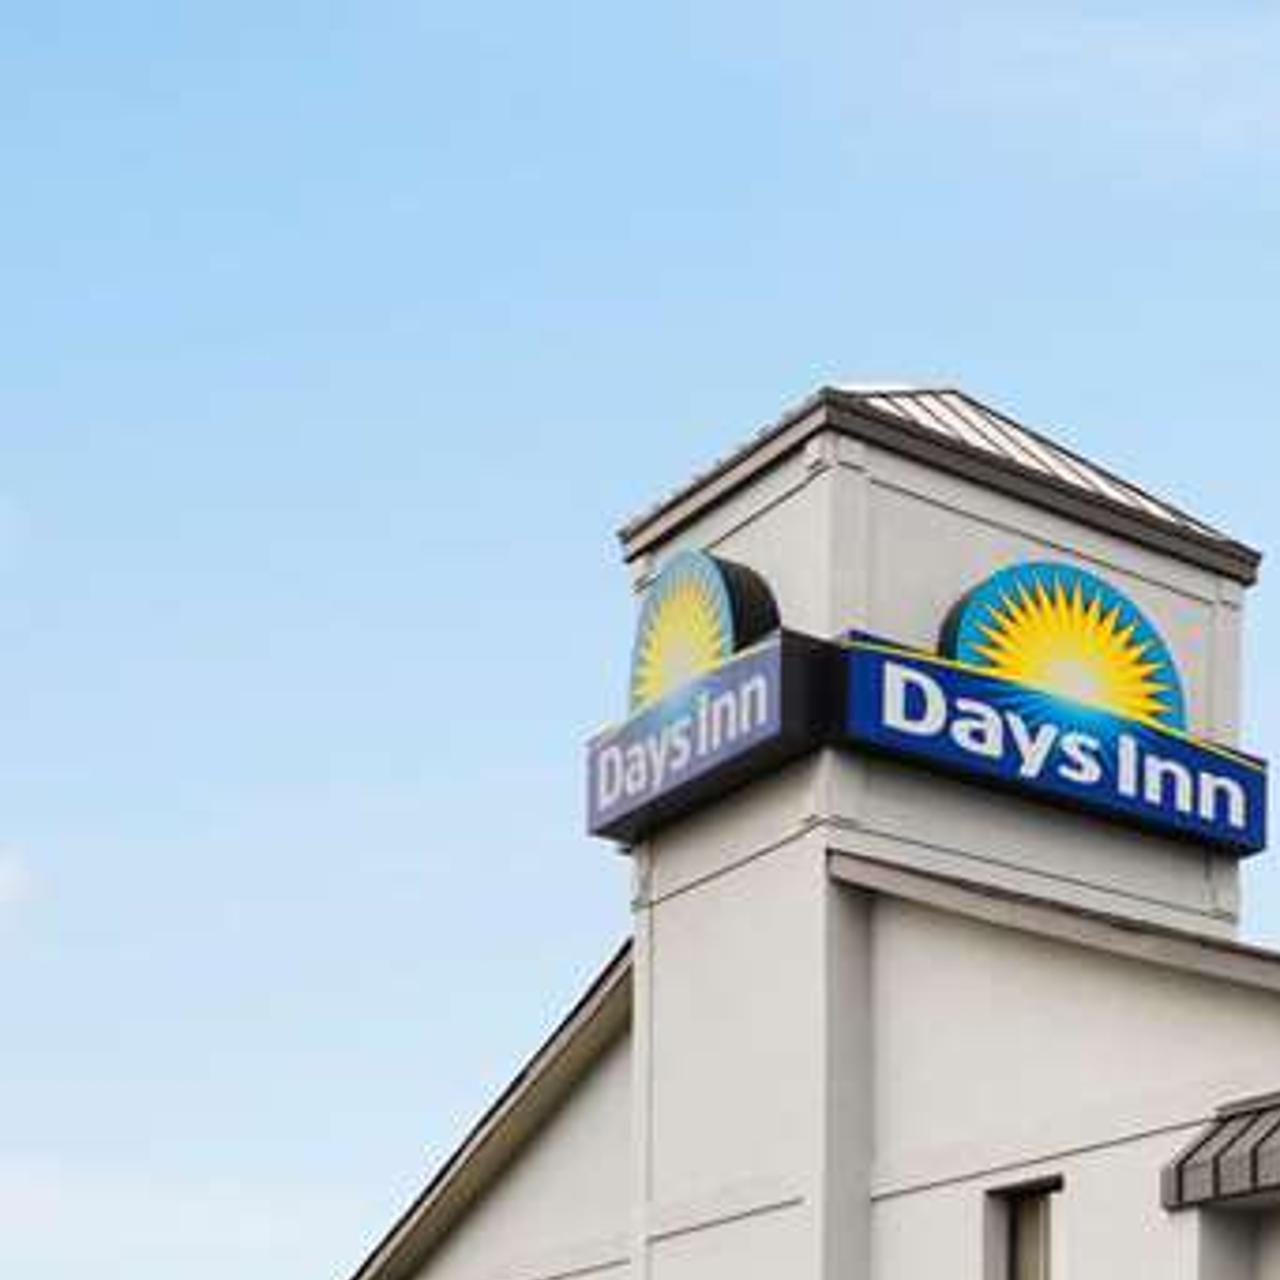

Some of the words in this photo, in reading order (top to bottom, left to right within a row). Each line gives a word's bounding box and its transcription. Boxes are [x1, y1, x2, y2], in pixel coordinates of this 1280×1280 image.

[599, 714, 692, 806] Days
[698, 672, 767, 755] Inn
[882, 662, 1101, 783] Days
[1118, 733, 1247, 828] Inn
